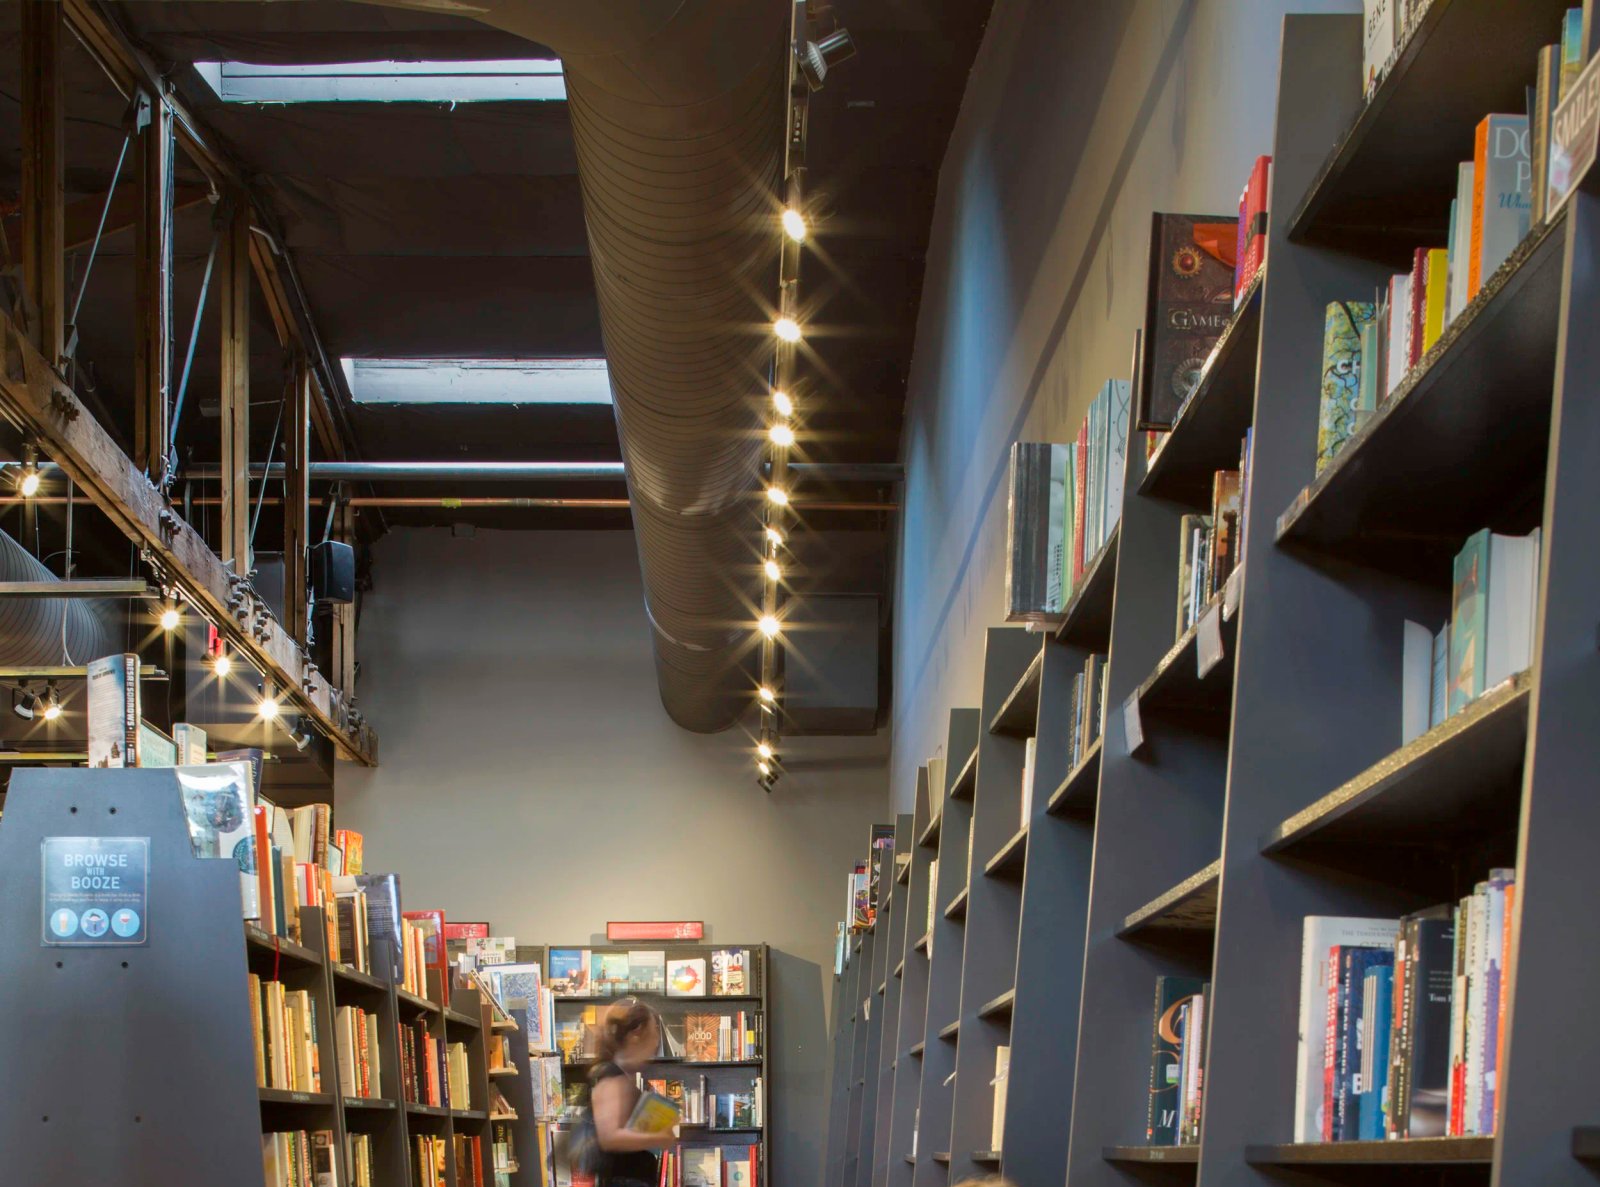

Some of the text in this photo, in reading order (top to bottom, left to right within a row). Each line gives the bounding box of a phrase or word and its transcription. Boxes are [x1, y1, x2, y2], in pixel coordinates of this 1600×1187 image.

[64, 854, 128, 867] BROWSE
[86, 868, 105, 876] WITH
[71, 877, 121, 889] BOOZE
